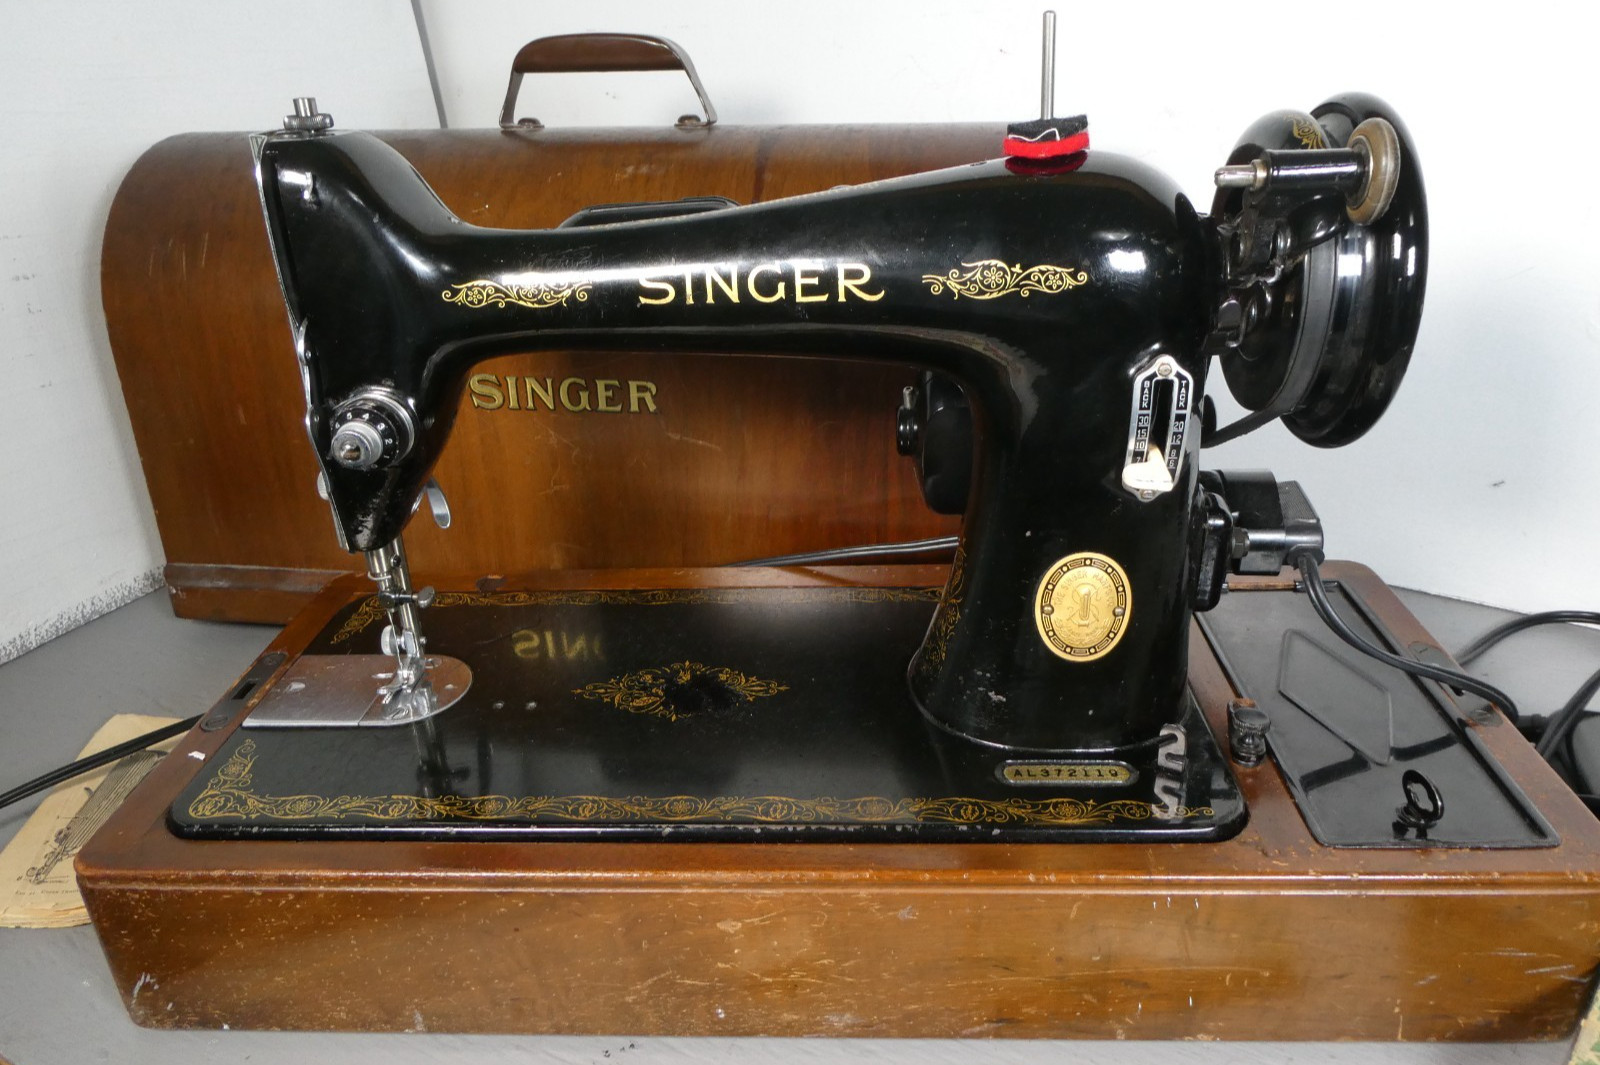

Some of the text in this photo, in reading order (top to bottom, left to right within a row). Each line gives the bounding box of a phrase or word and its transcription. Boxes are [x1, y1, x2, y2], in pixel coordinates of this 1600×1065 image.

[637, 261, 885, 305] SINGER
[468, 373, 659, 413] SINGER
[1142, 380, 1151, 409] BACK
[1178, 380, 1188, 408] TACK
[1138, 416, 1149, 426] 30
[1173, 421, 1184, 431] 20
[1137, 429, 1147, 439] 15
[1172, 434, 1181, 444] 12
[1135, 441, 1145, 450] 10
[1170, 449, 1176, 458] 8
[1169, 459, 1175, 468] 6
